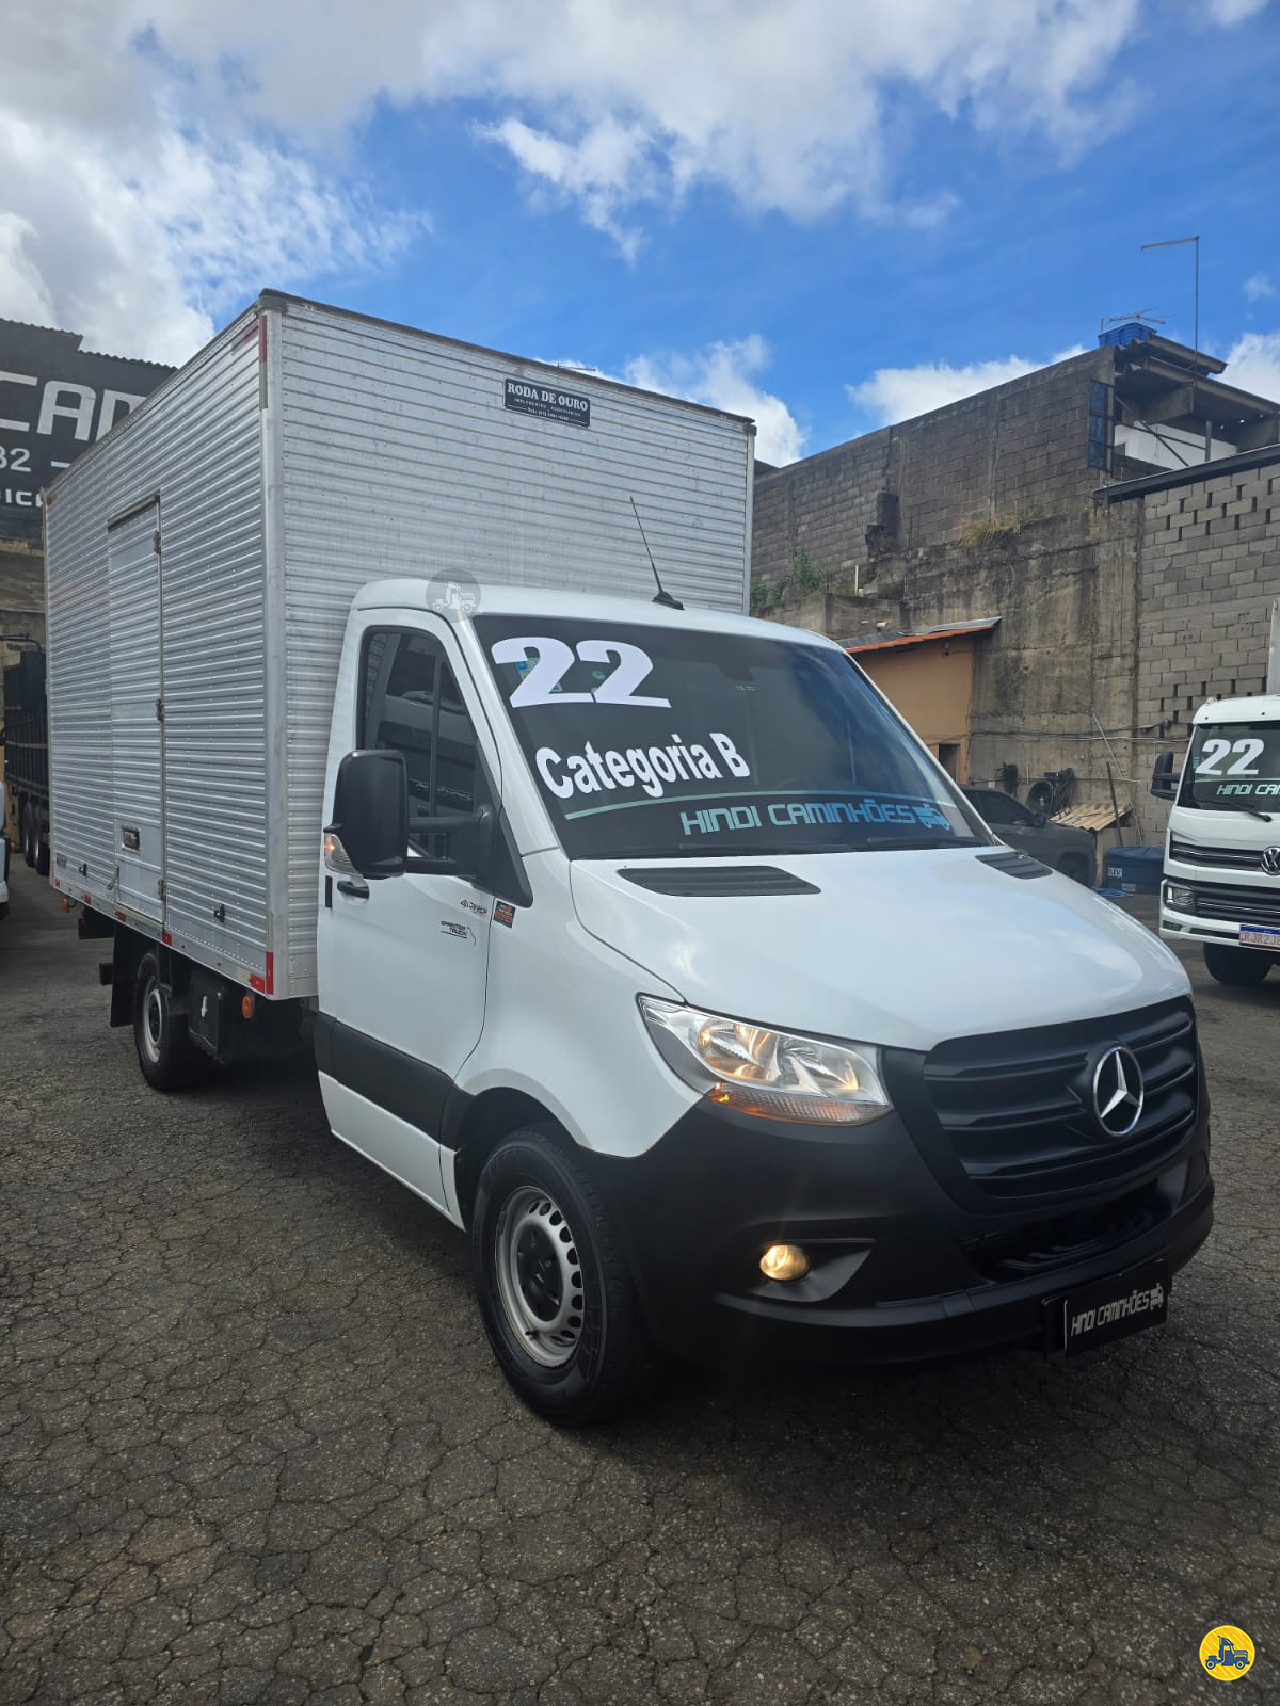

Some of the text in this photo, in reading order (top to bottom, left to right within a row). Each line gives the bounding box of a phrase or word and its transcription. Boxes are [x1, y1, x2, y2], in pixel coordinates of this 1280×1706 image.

[507, 382, 539, 400] RODA
[541, 390, 557, 404] DE
[558, 395, 588, 412] OURO
[0, 488, 45, 507] IC
[491, 637, 672, 709] 22
[536, 733, 750, 799] Categoria B
[1195, 738, 1265, 776] 22
[1216, 784, 1253, 795] HINDI
[680, 799, 917, 836] HINDI CAMINHÕES
[1097, 1289, 1150, 1326] CAMINHÕES
